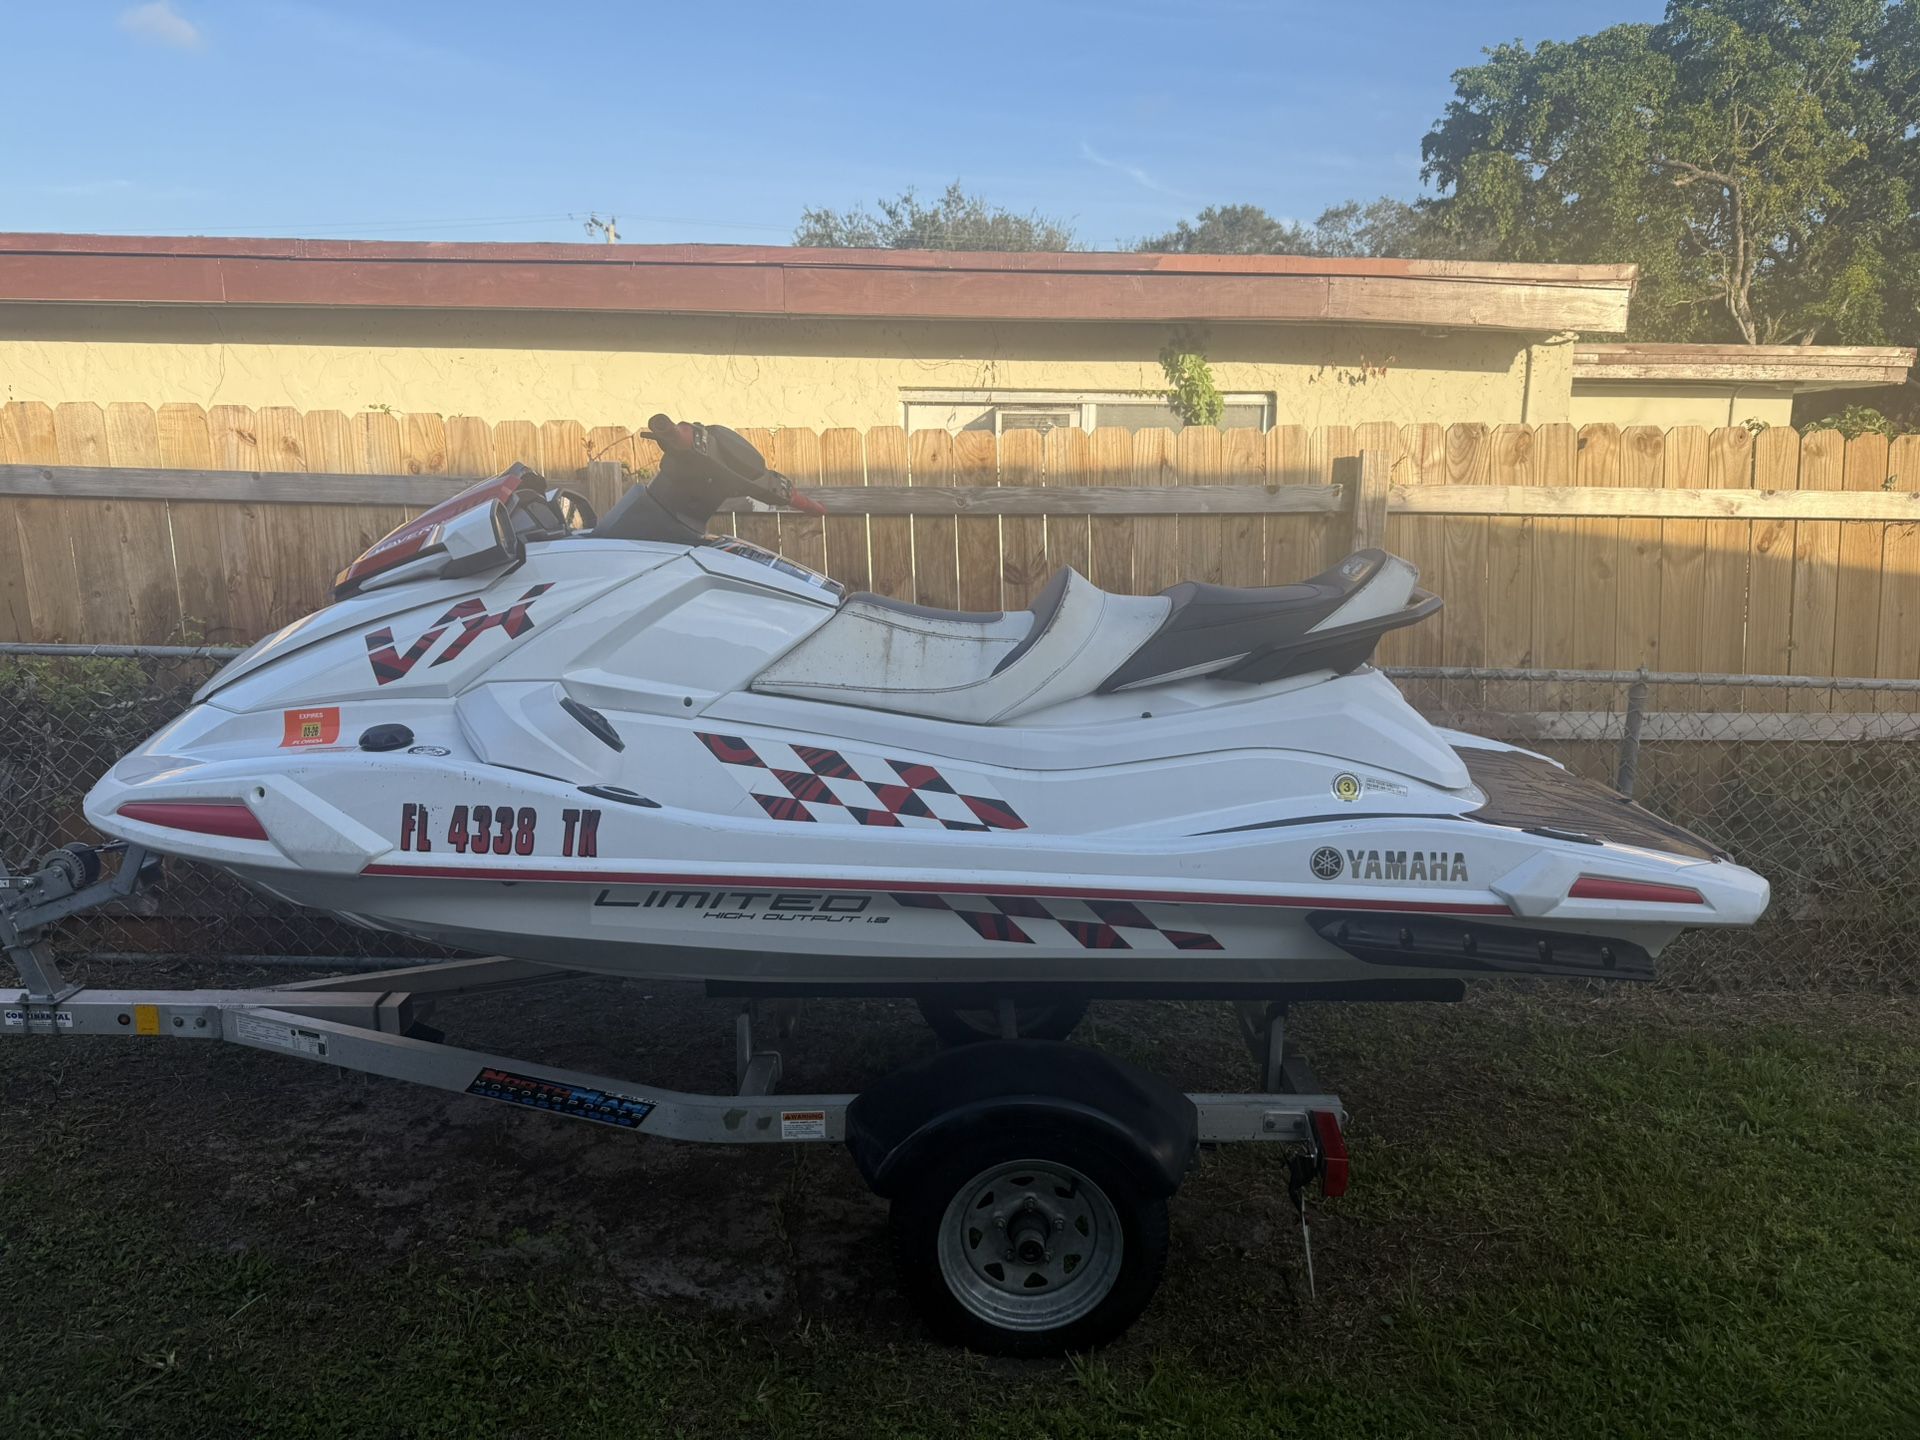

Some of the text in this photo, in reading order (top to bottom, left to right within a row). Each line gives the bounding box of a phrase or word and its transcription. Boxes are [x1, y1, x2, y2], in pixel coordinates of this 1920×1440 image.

[364, 582, 556, 686] VX
[298, 712, 324, 720] EXPIRES
[1343, 782, 1351, 792] 3
[400, 803, 602, 858] FL 4338 TK
[1346, 849, 1468, 881] YAMAHA
[594, 889, 872, 913] LIMITED
[703, 911, 756, 920] HIGH
[762, 913, 861, 923] OUTPUT
[474, 1080, 642, 1119] MOTORSPORTS
